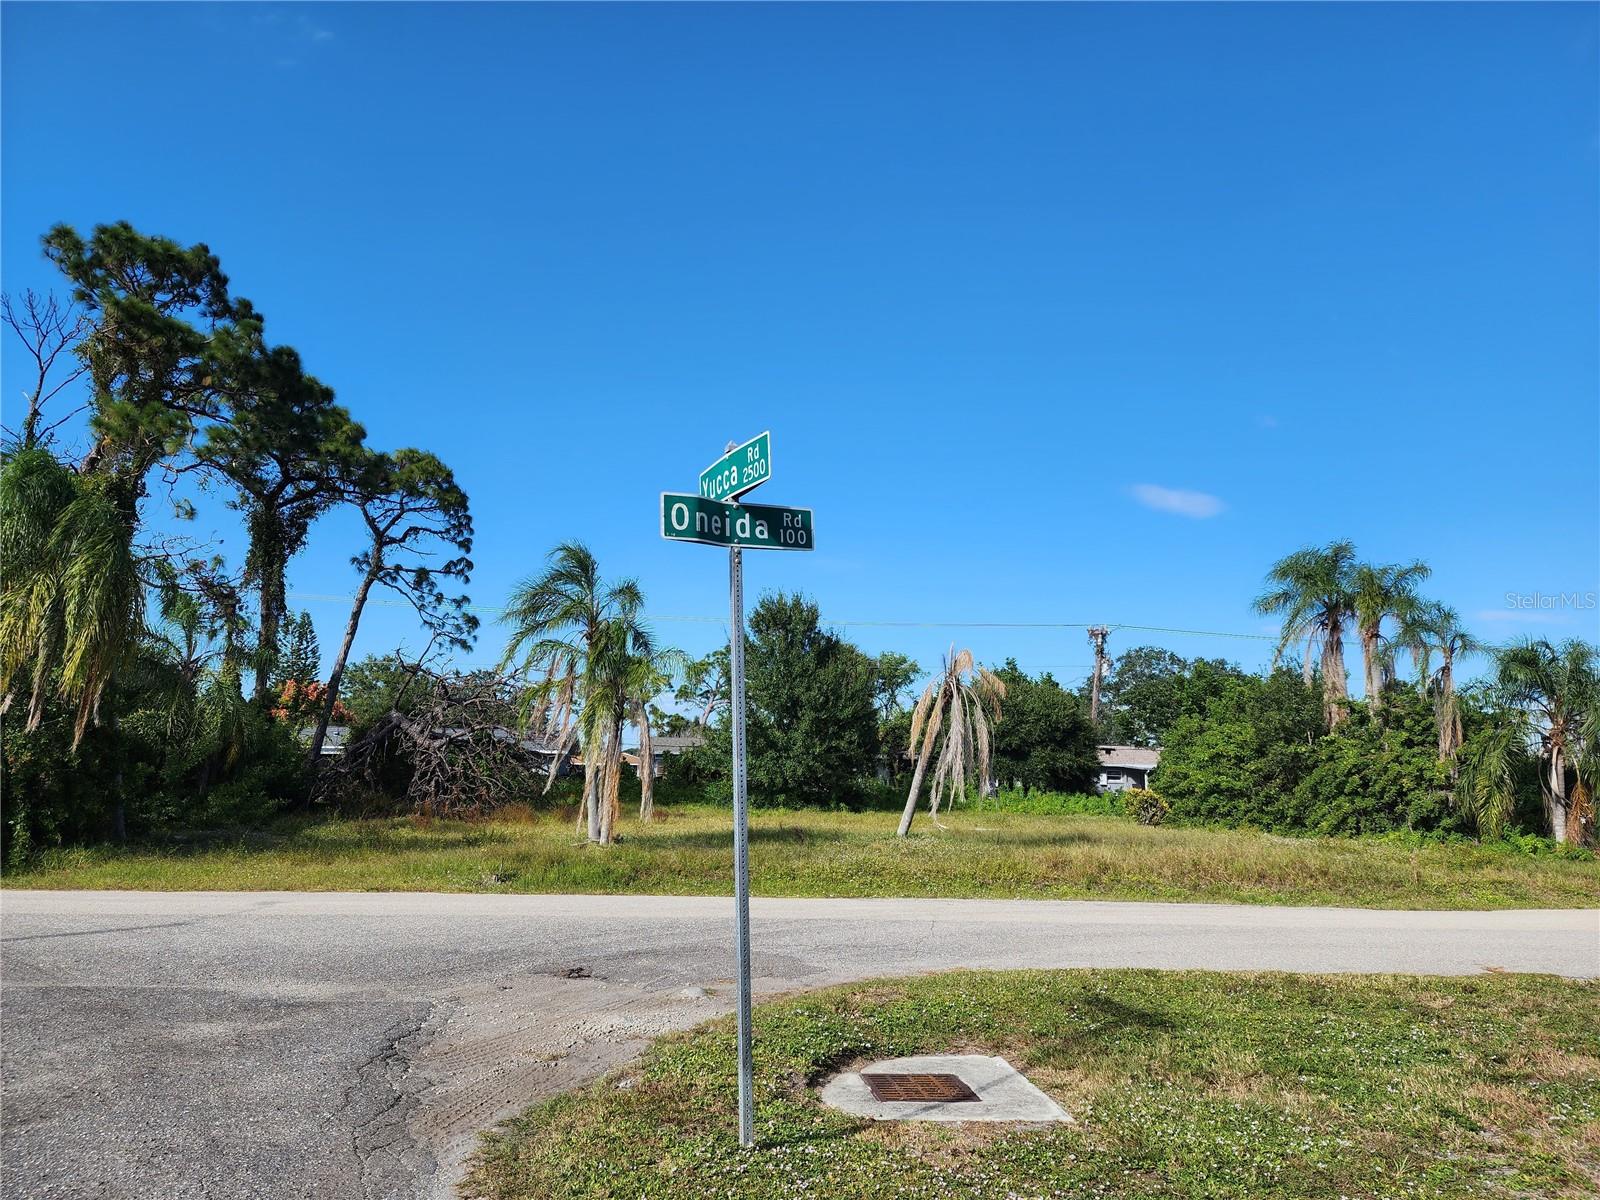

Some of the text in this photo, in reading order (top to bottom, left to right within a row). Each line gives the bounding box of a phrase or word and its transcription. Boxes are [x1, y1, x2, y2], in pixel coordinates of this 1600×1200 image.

[702, 443, 760, 499] Yucca Rd
[742, 459, 766, 483] 2500
[671, 503, 802, 539] Oneida Rd
[779, 529, 806, 545] 100
